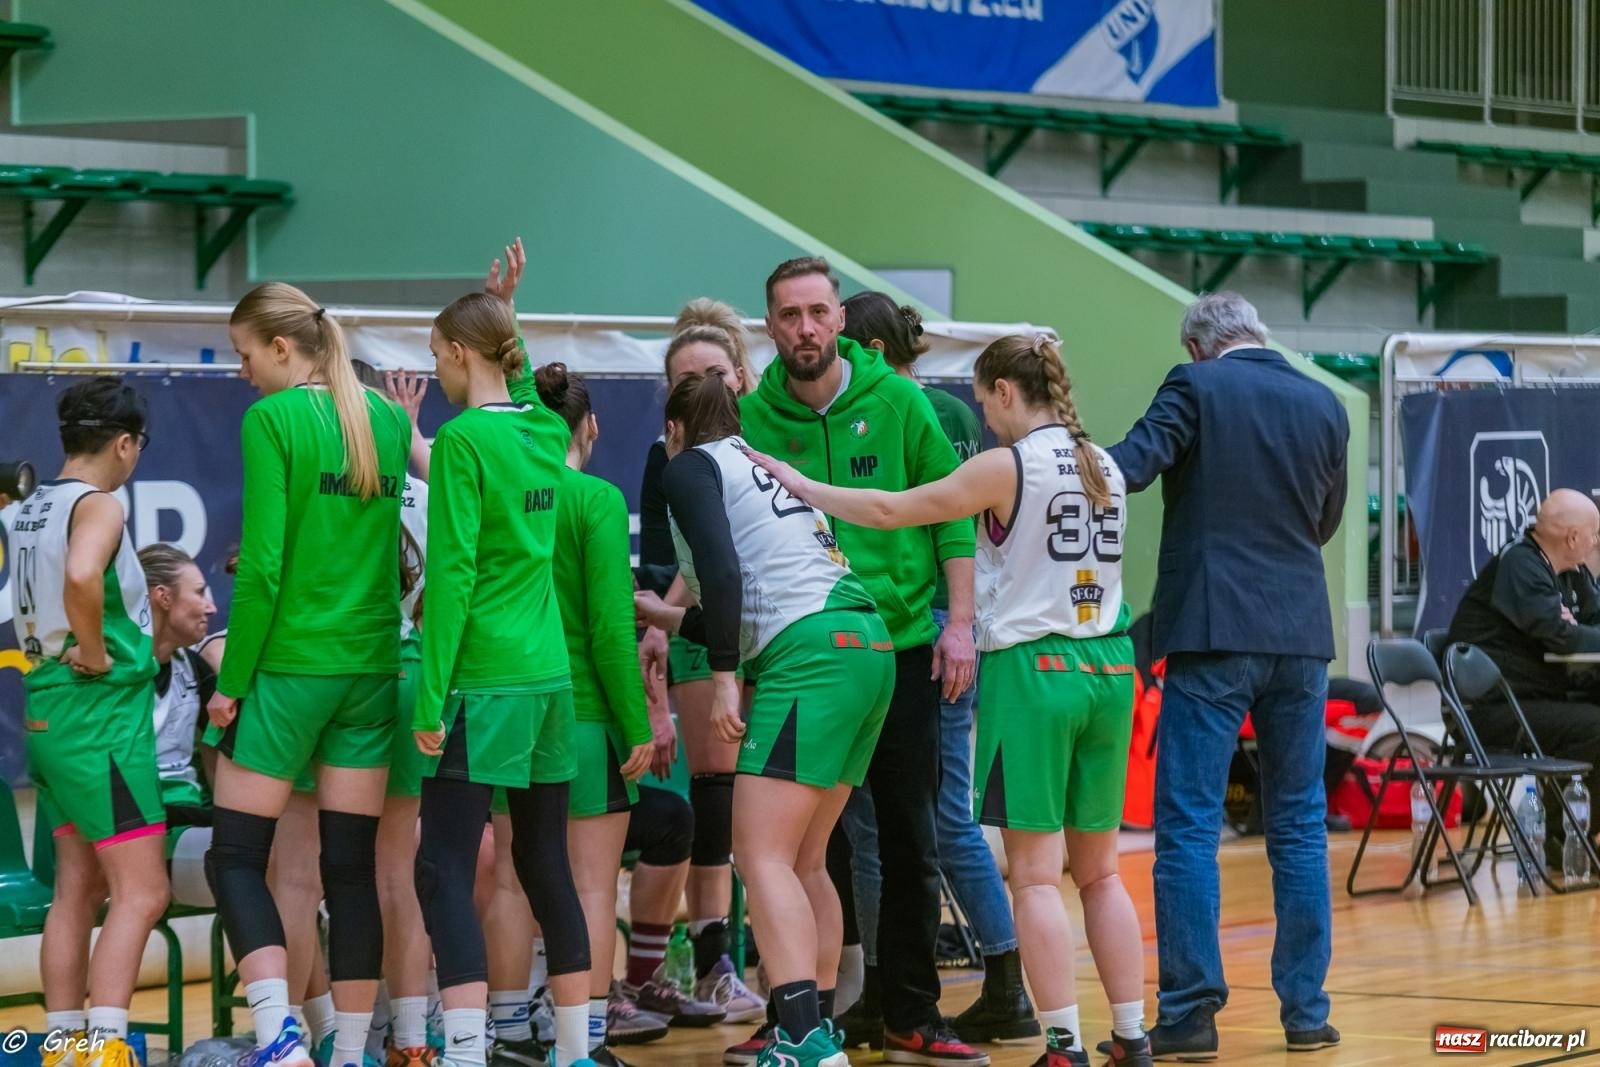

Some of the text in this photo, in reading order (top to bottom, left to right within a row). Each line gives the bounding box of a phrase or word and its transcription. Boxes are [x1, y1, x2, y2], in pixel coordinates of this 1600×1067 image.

[850, 455, 878, 478] MP
[524, 487, 554, 513] BACH
[1046, 491, 1121, 563] 33
